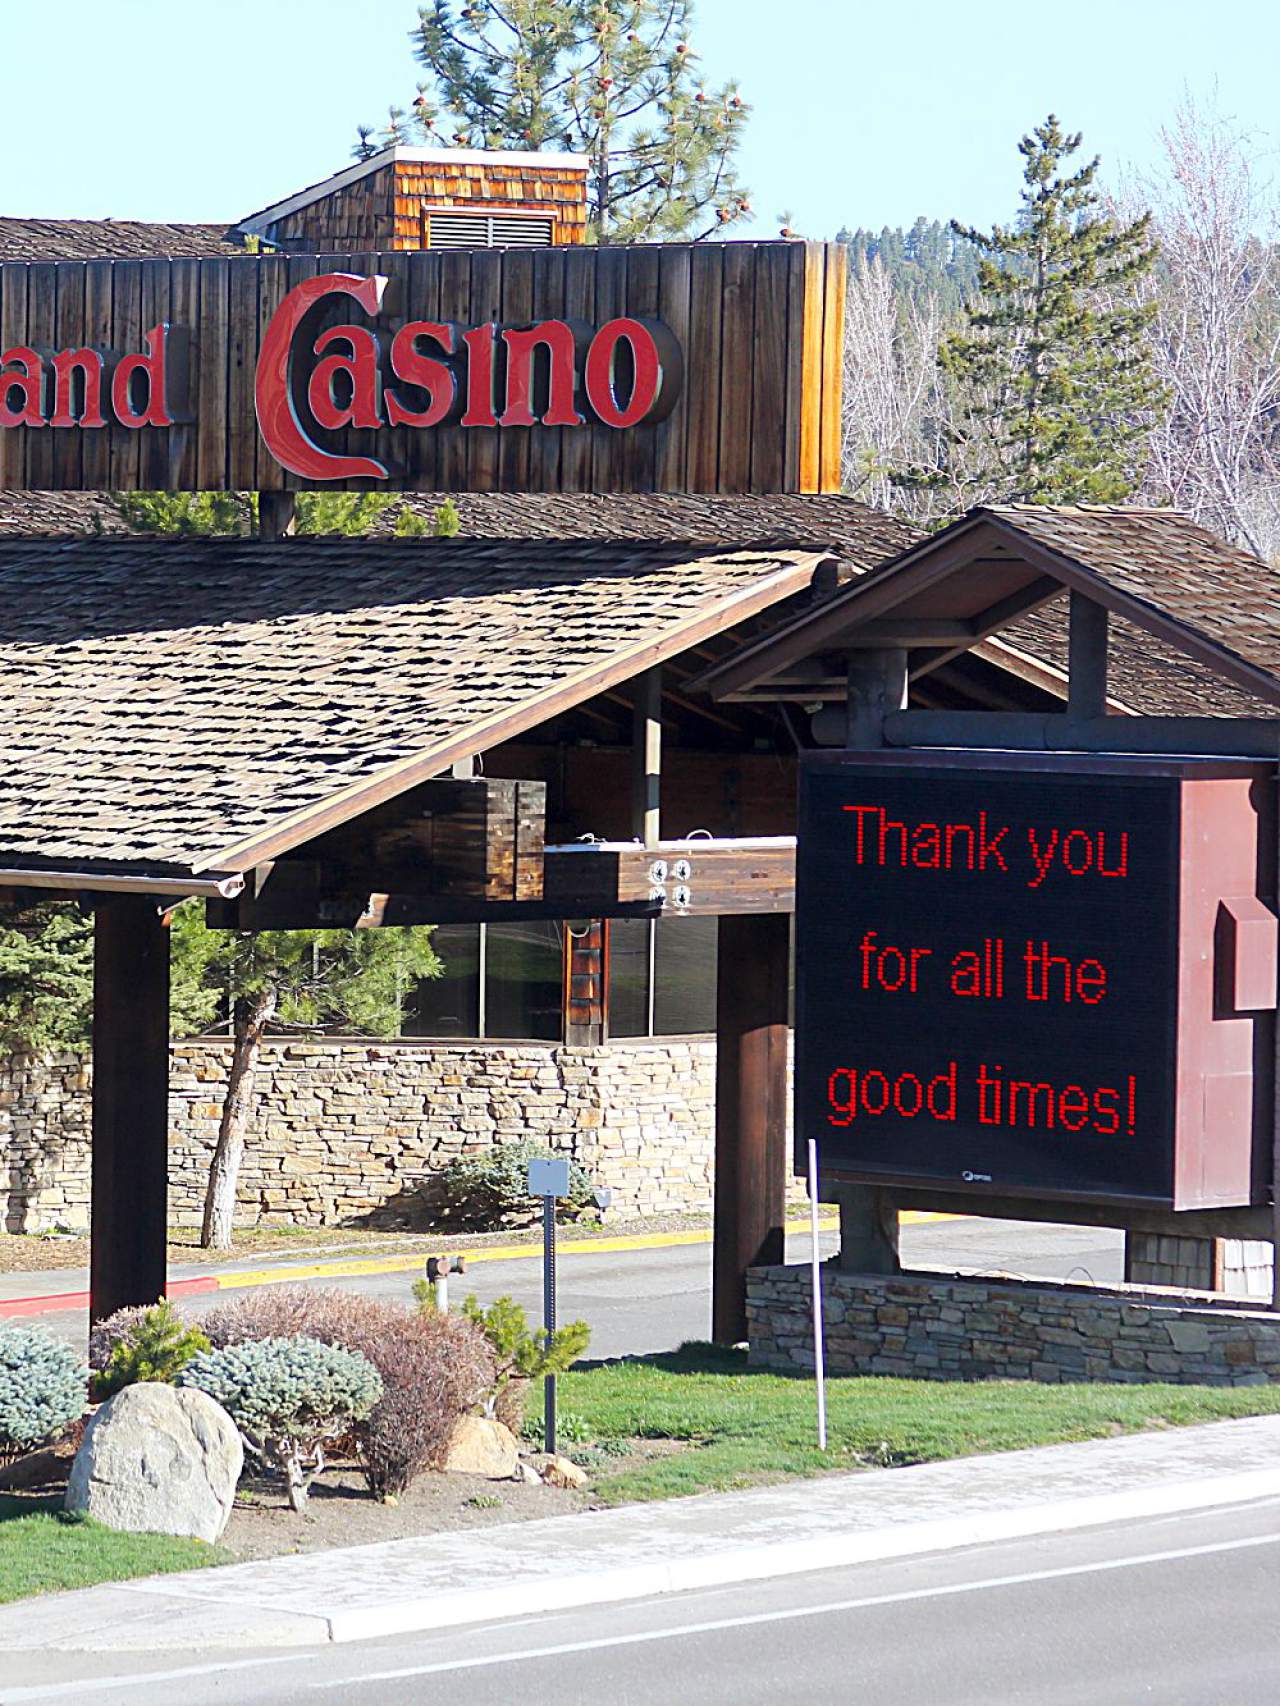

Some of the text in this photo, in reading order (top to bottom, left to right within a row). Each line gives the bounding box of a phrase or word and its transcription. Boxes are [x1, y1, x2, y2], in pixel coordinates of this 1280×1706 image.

[254, 273, 660, 480] Casino
[842, 805, 1128, 888] Thank you
[859, 931, 1106, 1005] for all the
[828, 1061, 1136, 1136] good times!
